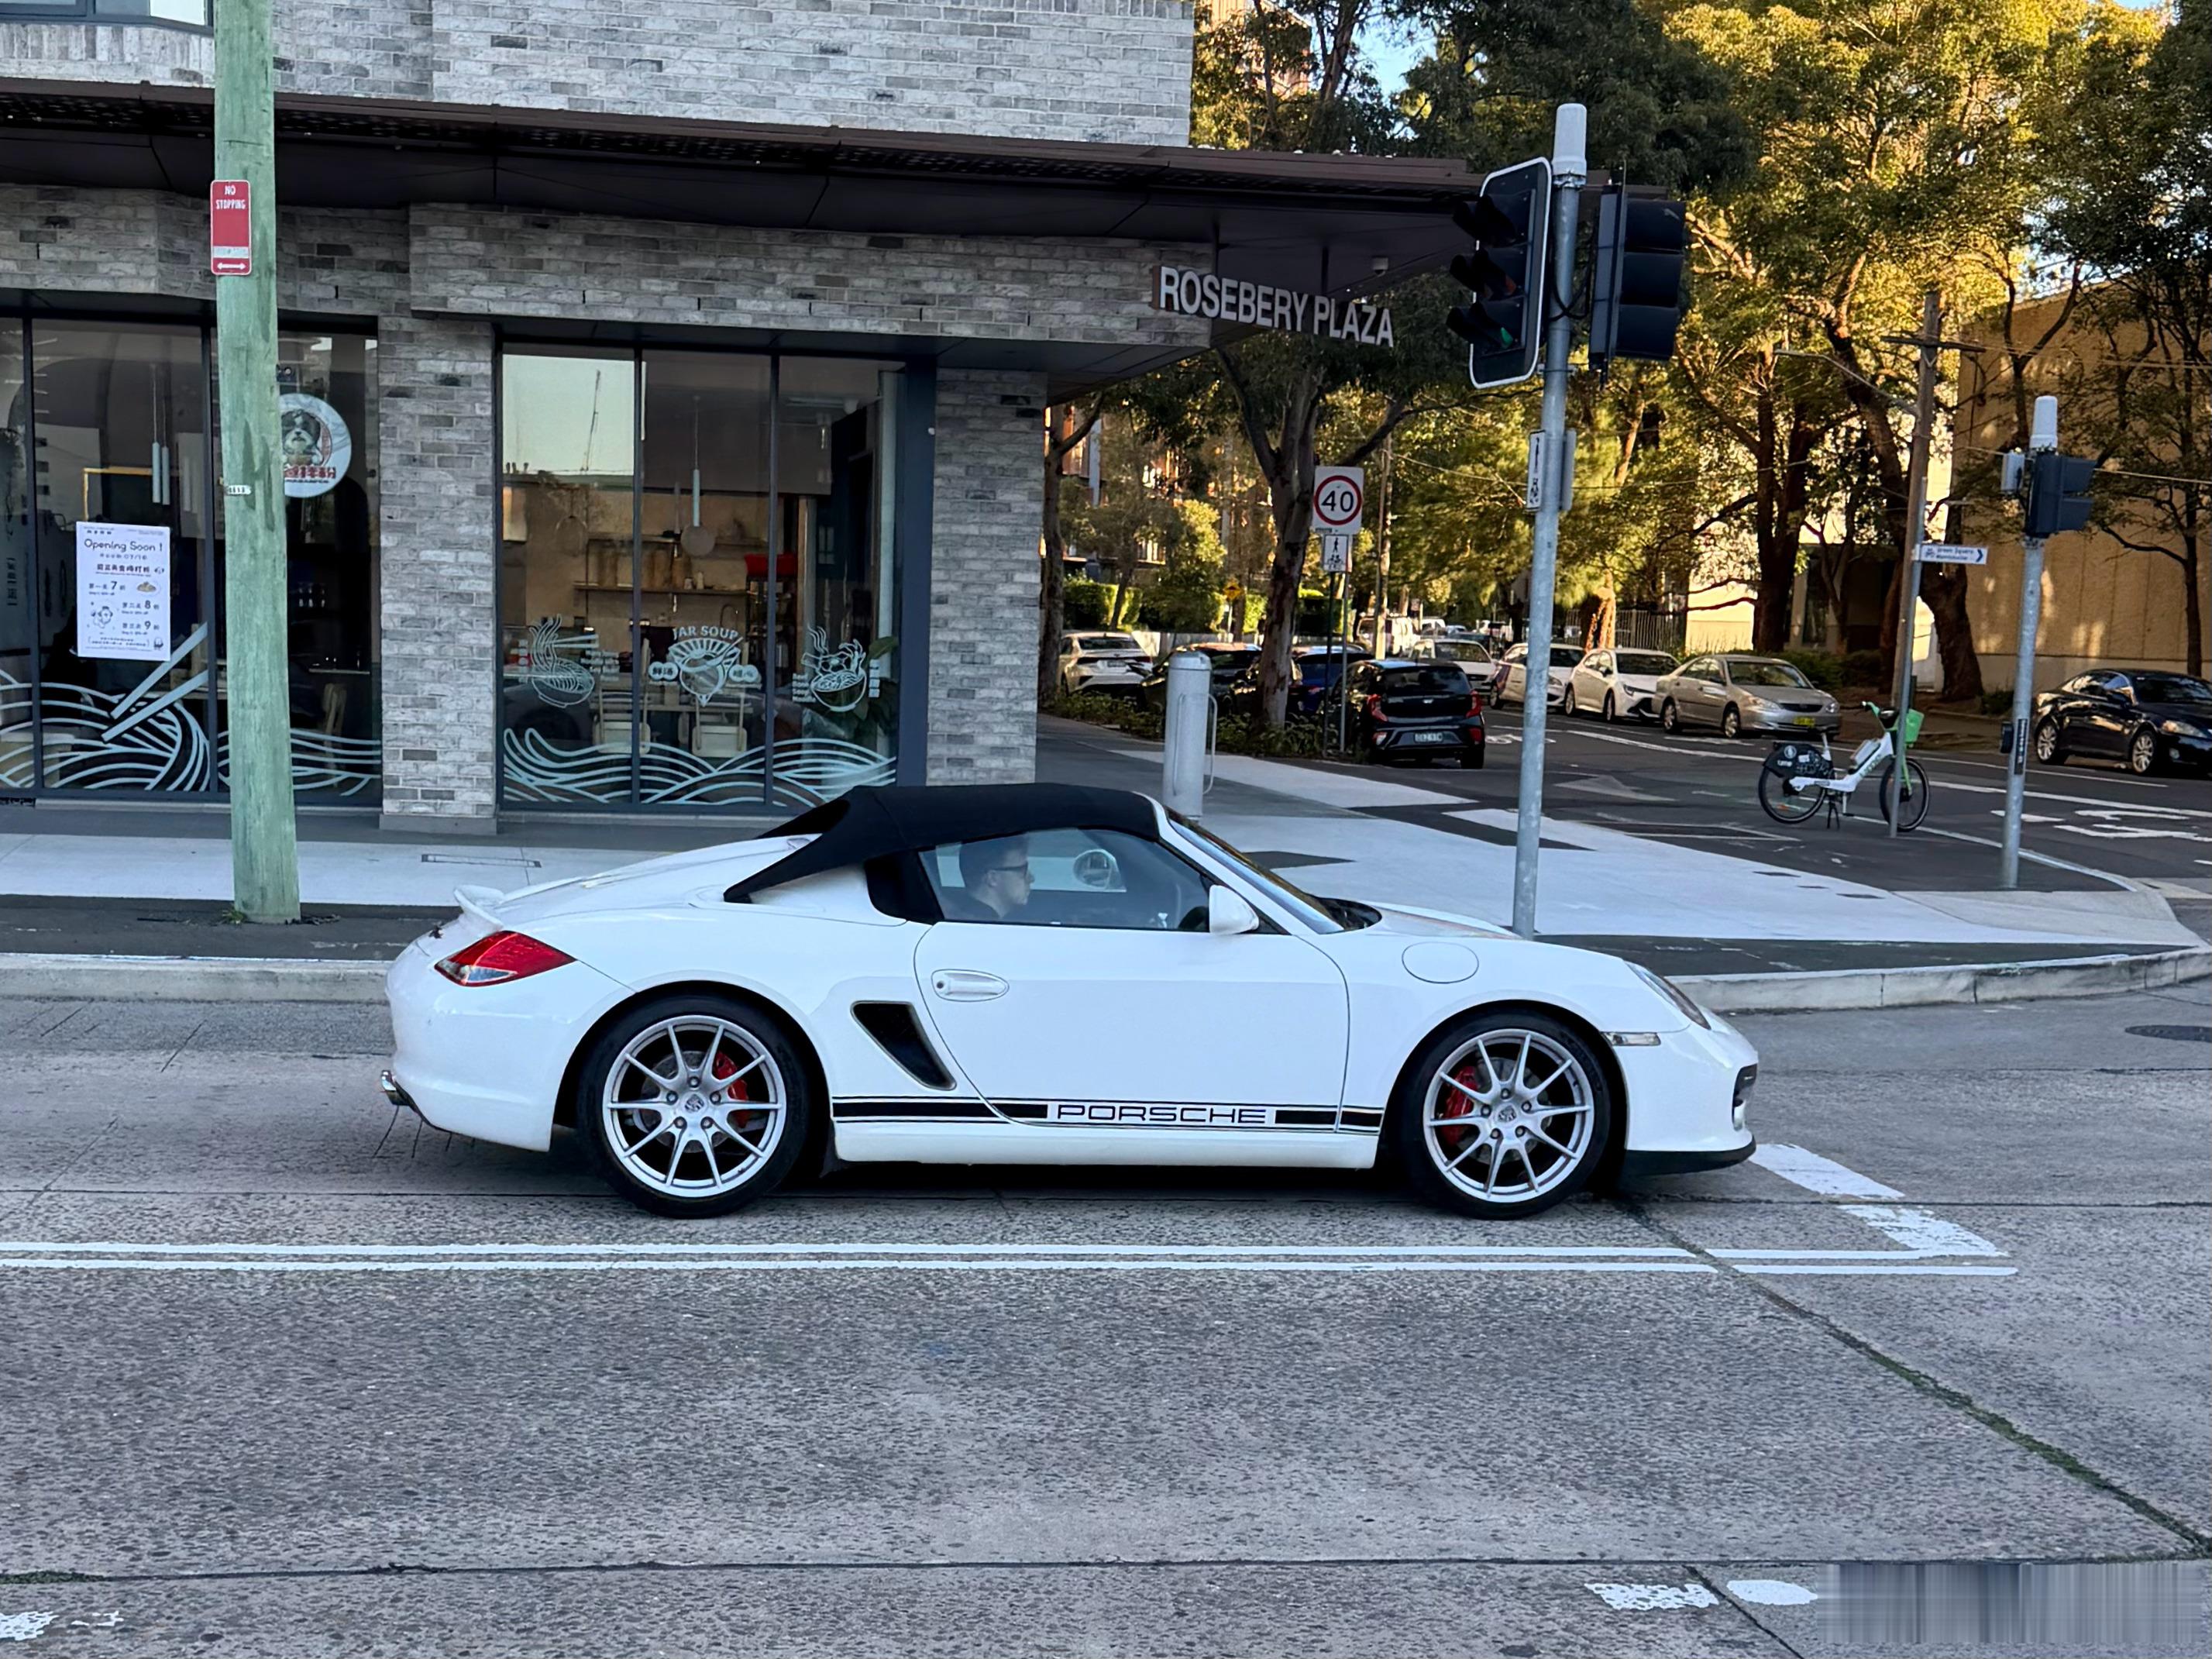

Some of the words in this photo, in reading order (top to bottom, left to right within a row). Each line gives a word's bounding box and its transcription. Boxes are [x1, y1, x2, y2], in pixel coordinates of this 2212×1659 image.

[225, 184, 236, 196] NO
[215, 199, 246, 210] STOPPING
[1160, 266, 1309, 332] ROSEBERY
[1313, 294, 1394, 348] PLAZA
[1321, 490, 1354, 512] 40
[84, 539, 126, 552] Opening
[129, 541, 156, 552] Soon
[672, 625, 697, 640] JAR
[700, 625, 739, 640] SOUP
[1057, 1103, 1267, 1125] PORSCHE
